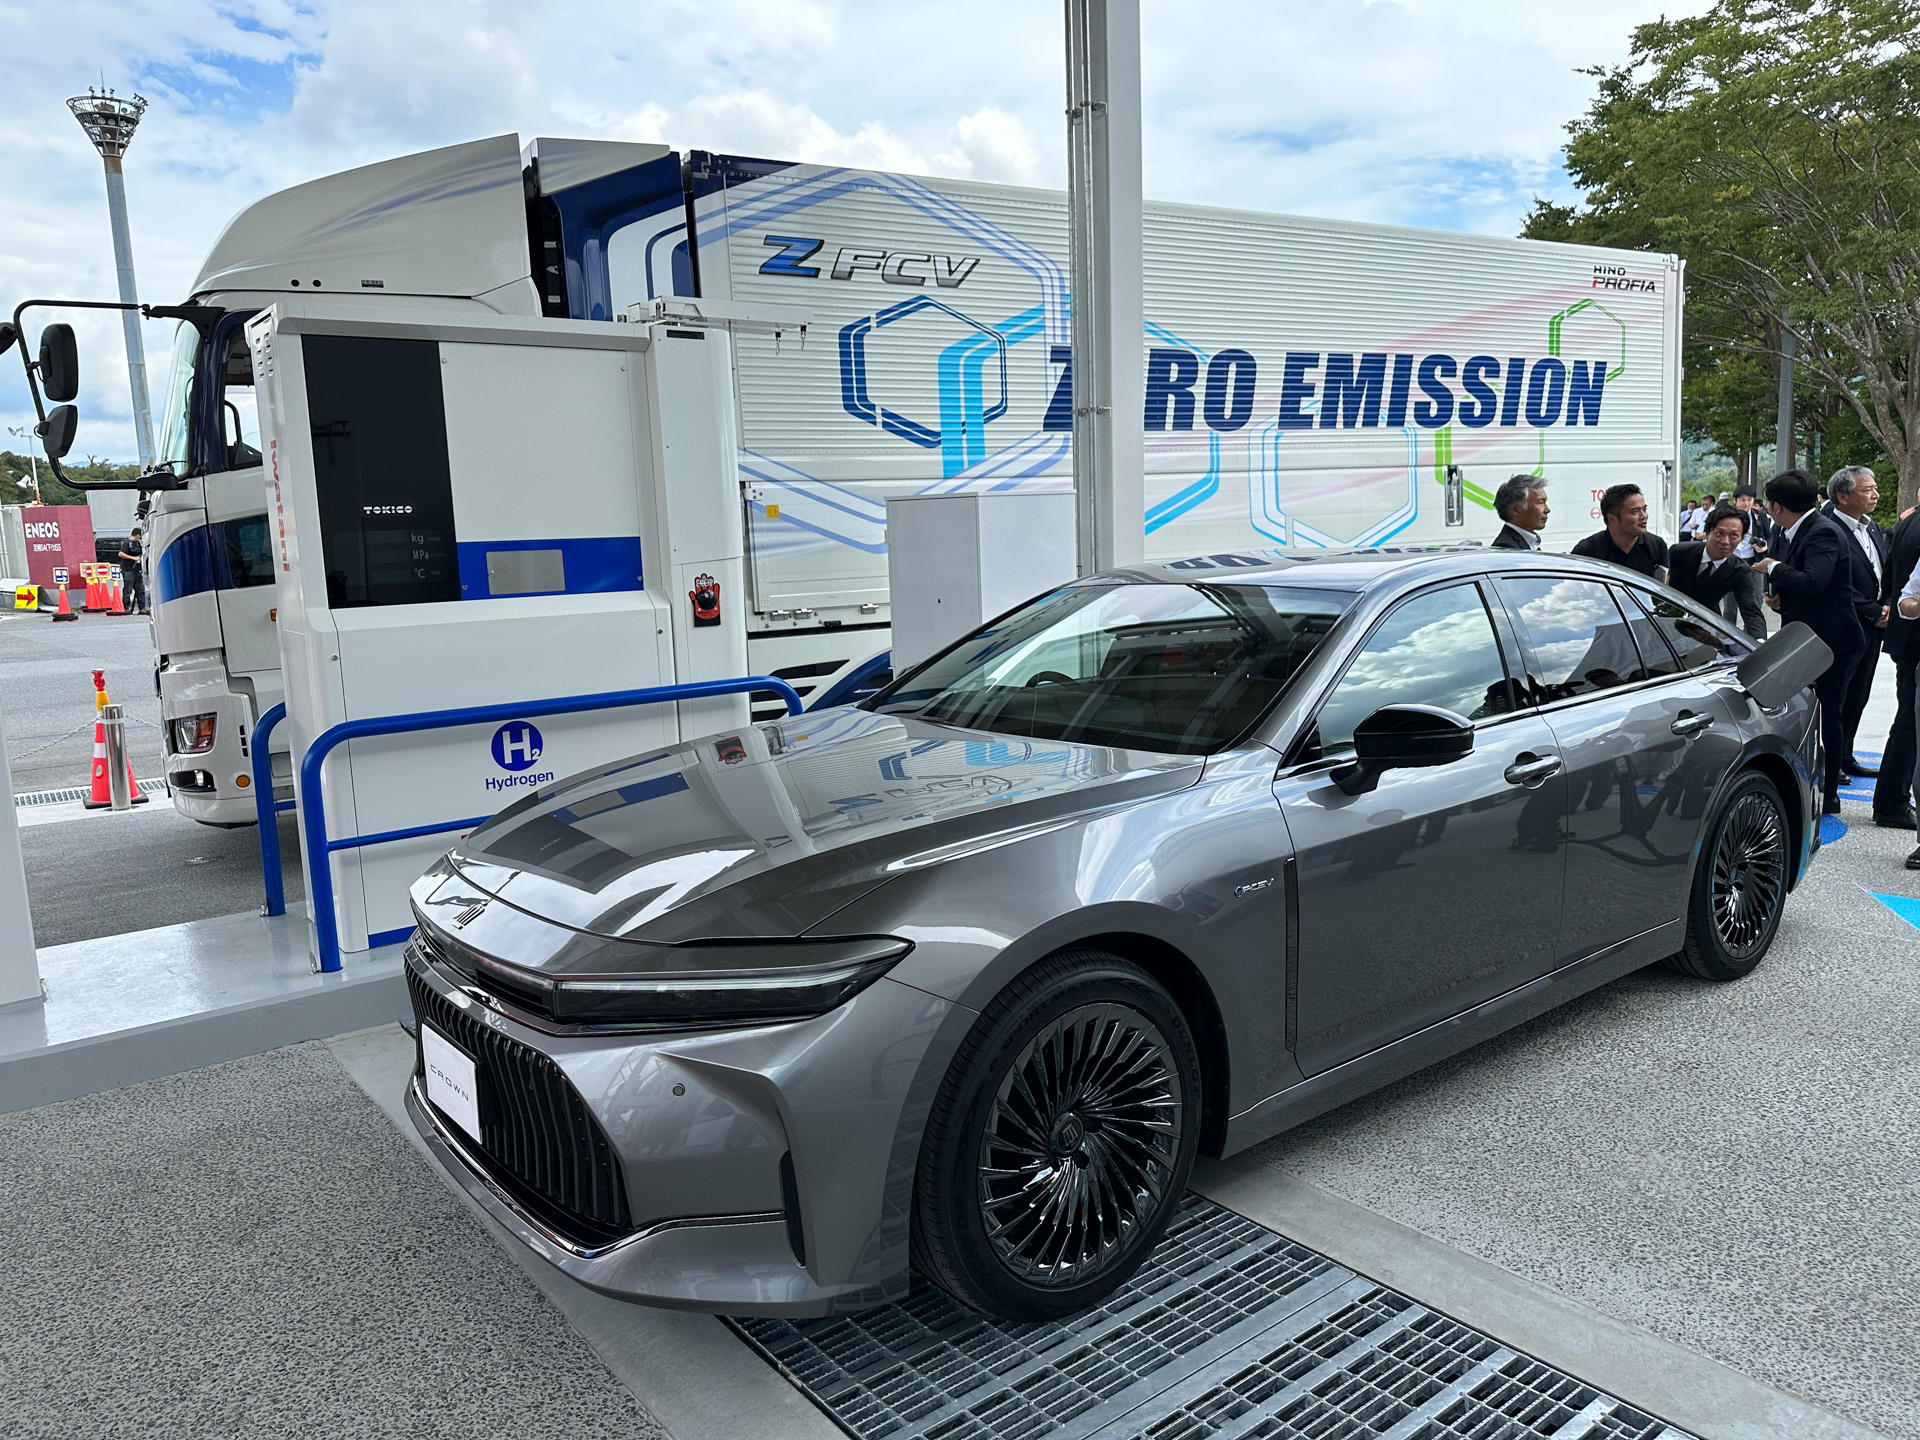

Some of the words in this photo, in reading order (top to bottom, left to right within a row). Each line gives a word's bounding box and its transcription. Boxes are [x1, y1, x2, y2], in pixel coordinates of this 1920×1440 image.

[759, 234, 825, 279] Z
[830, 247, 982, 289] FCV
[1593, 265, 1627, 277] HINO
[1592, 276, 1656, 293] PROFIA
[1042, 345, 1258, 432] ZRO
[1277, 351, 1608, 429] EMISSION
[363, 505, 413, 515] TOKICO
[24, 521, 60, 539] ENEOS
[411, 533, 424, 545] kg
[412, 549, 429, 560] MPa
[485, 771, 554, 792] Hydrogen
[430, 1064, 469, 1102] CROWN
